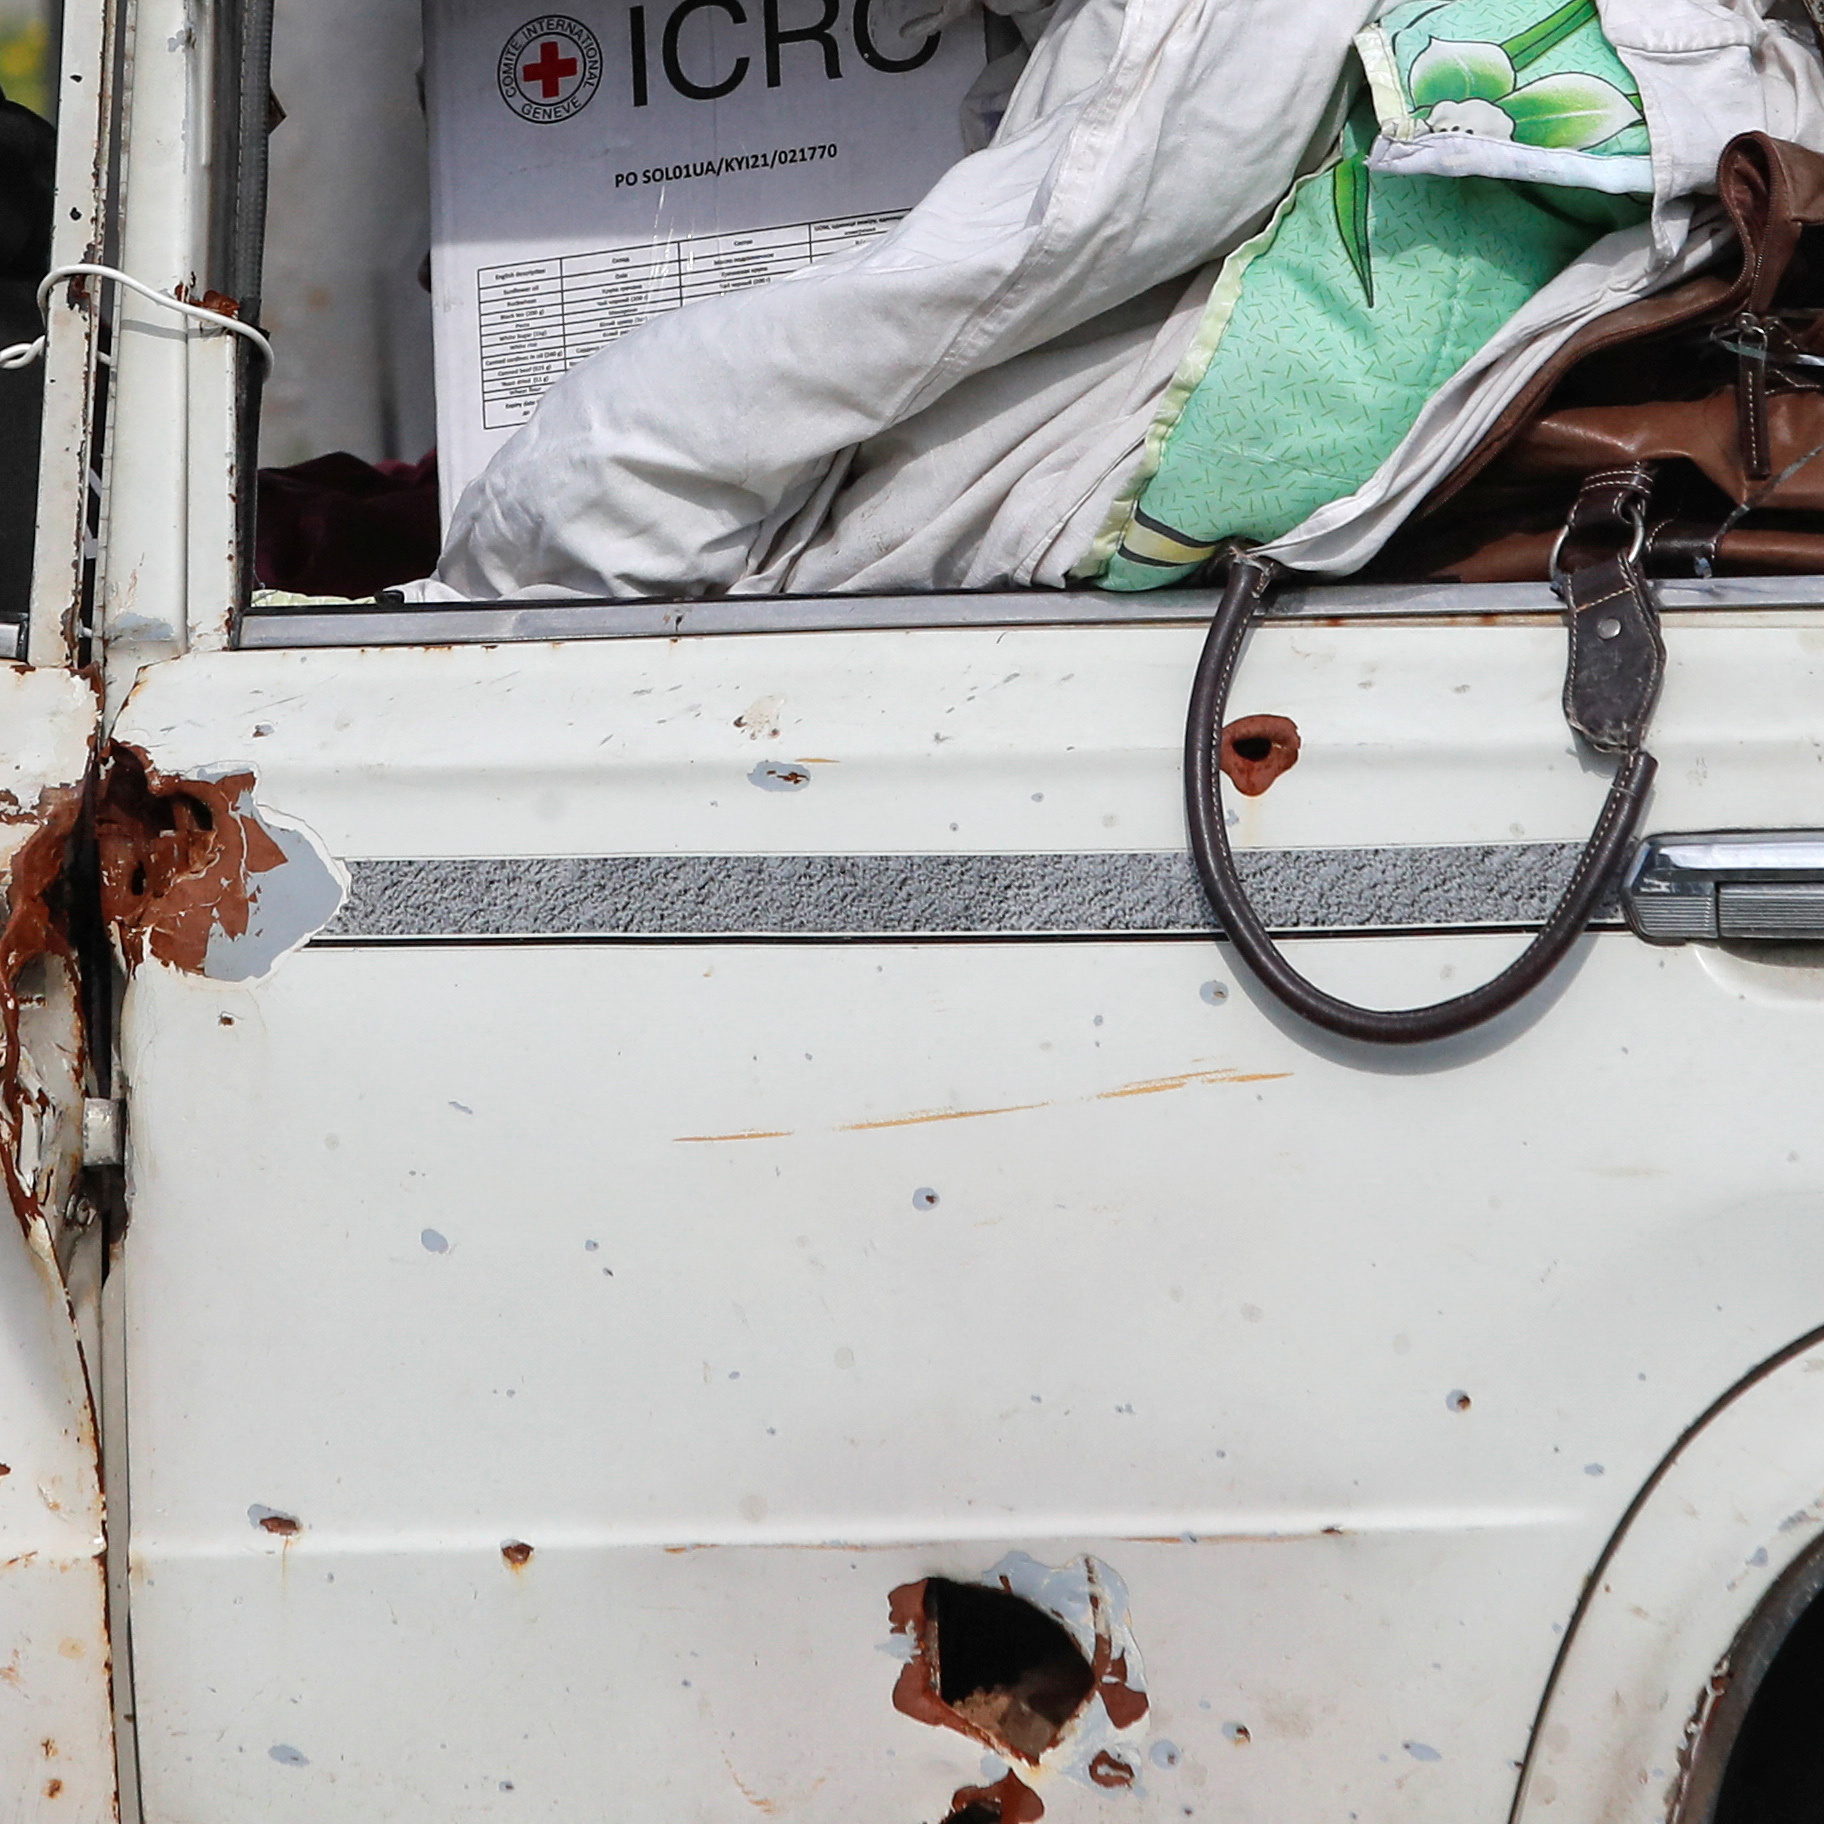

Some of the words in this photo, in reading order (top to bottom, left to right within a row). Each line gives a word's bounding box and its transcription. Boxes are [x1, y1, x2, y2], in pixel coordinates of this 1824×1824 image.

[501, 39, 523, 98] COMITE
[521, 18, 599, 89] INTERNATIONAL
[521, 97, 582, 120] GENEVE
[614, 172, 638, 188] PO
